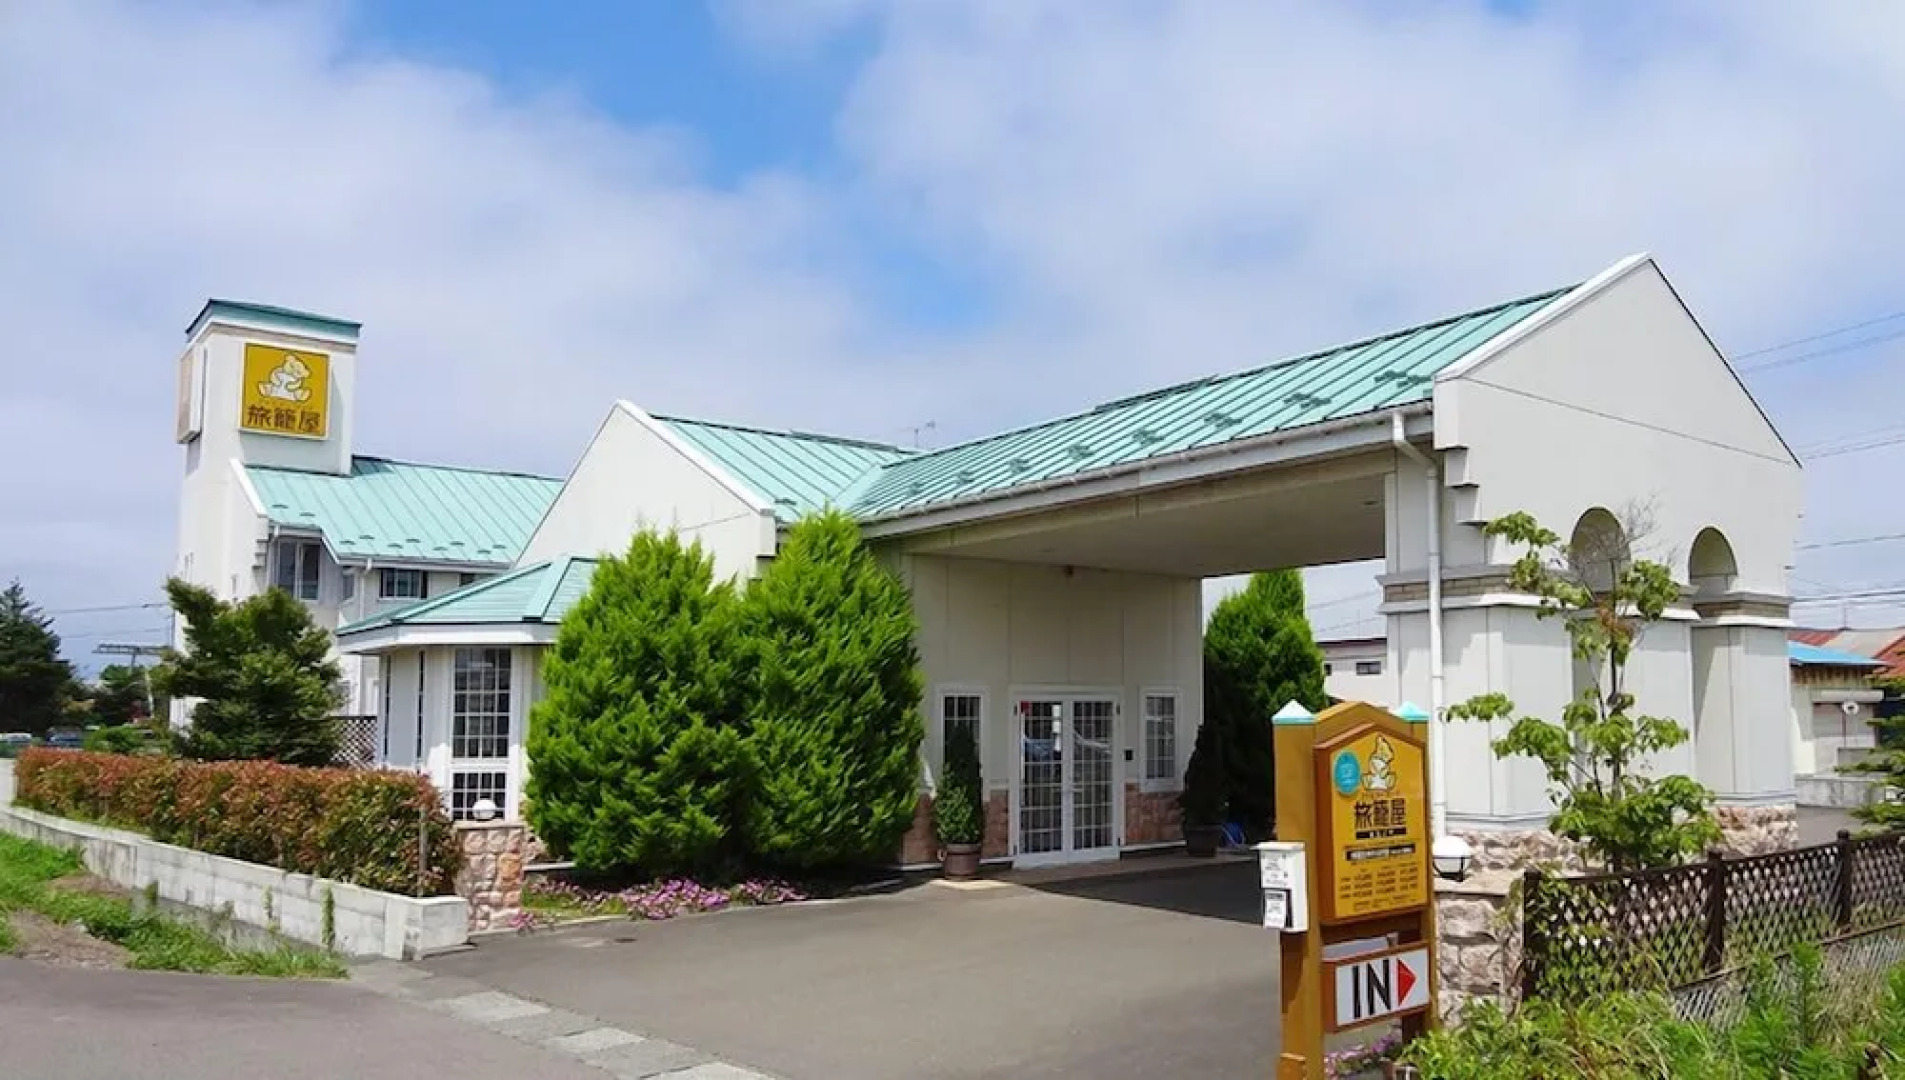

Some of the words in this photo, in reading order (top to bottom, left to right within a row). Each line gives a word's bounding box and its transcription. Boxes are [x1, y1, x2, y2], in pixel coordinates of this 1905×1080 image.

[247, 404, 321, 432] 旅籠屋
[1354, 798, 1407, 829] 旅籠屋
[1352, 958, 1392, 1020] IN
